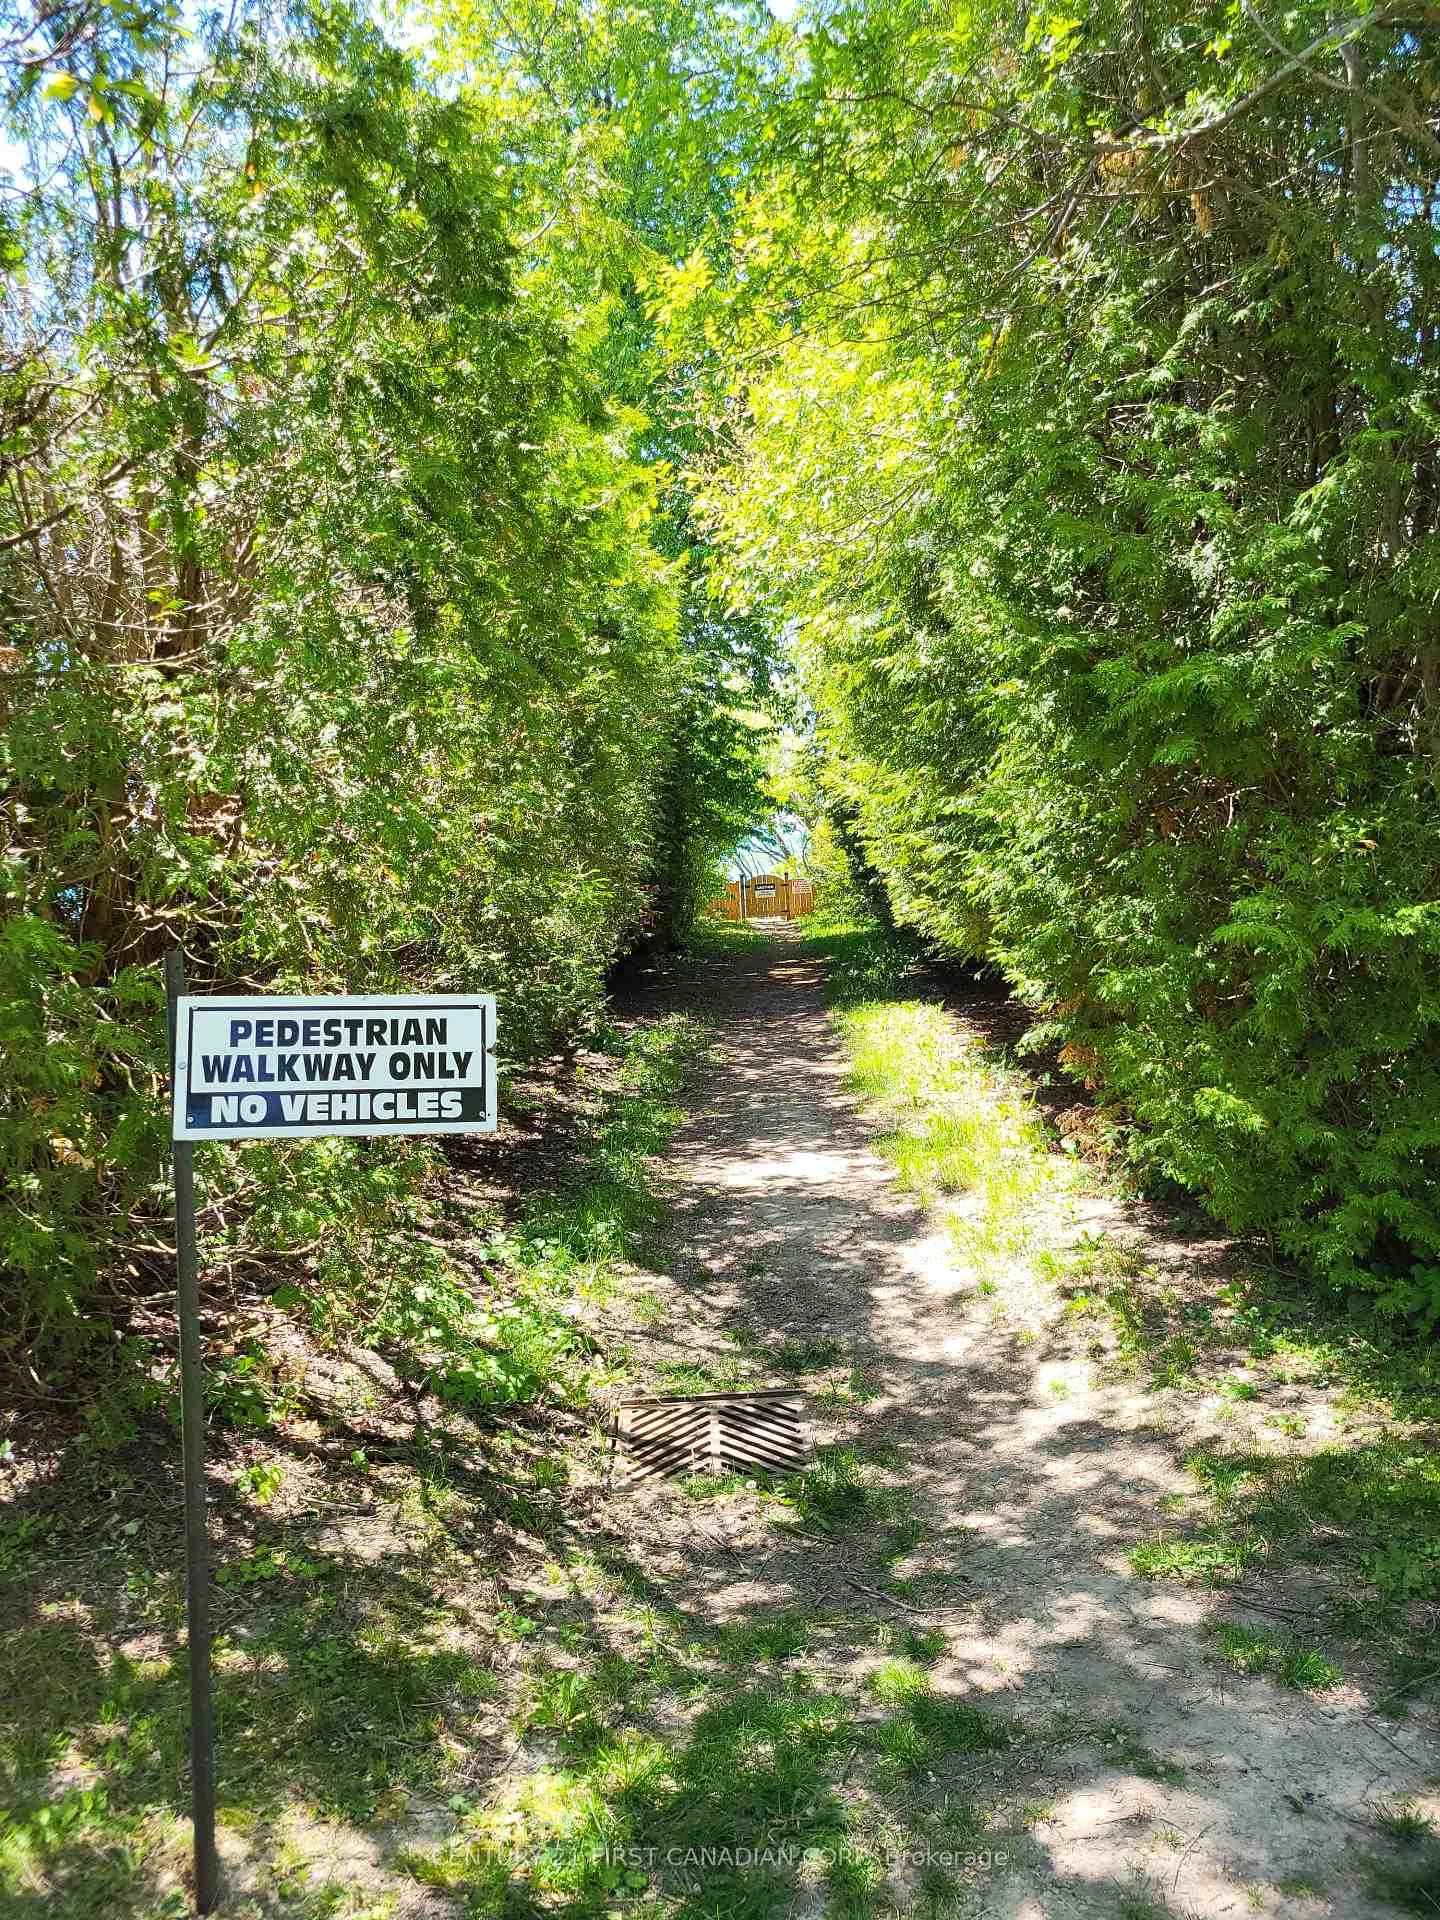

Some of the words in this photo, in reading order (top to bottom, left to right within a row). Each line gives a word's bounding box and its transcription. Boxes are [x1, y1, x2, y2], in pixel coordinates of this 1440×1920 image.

[230, 1018, 448, 1047] PEDESTRIAN
[202, 1052, 376, 1083] WALKWAY
[389, 1051, 473, 1080] ONLY
[211, 1095, 267, 1123] NO
[281, 1092, 463, 1121] VEHICLES
